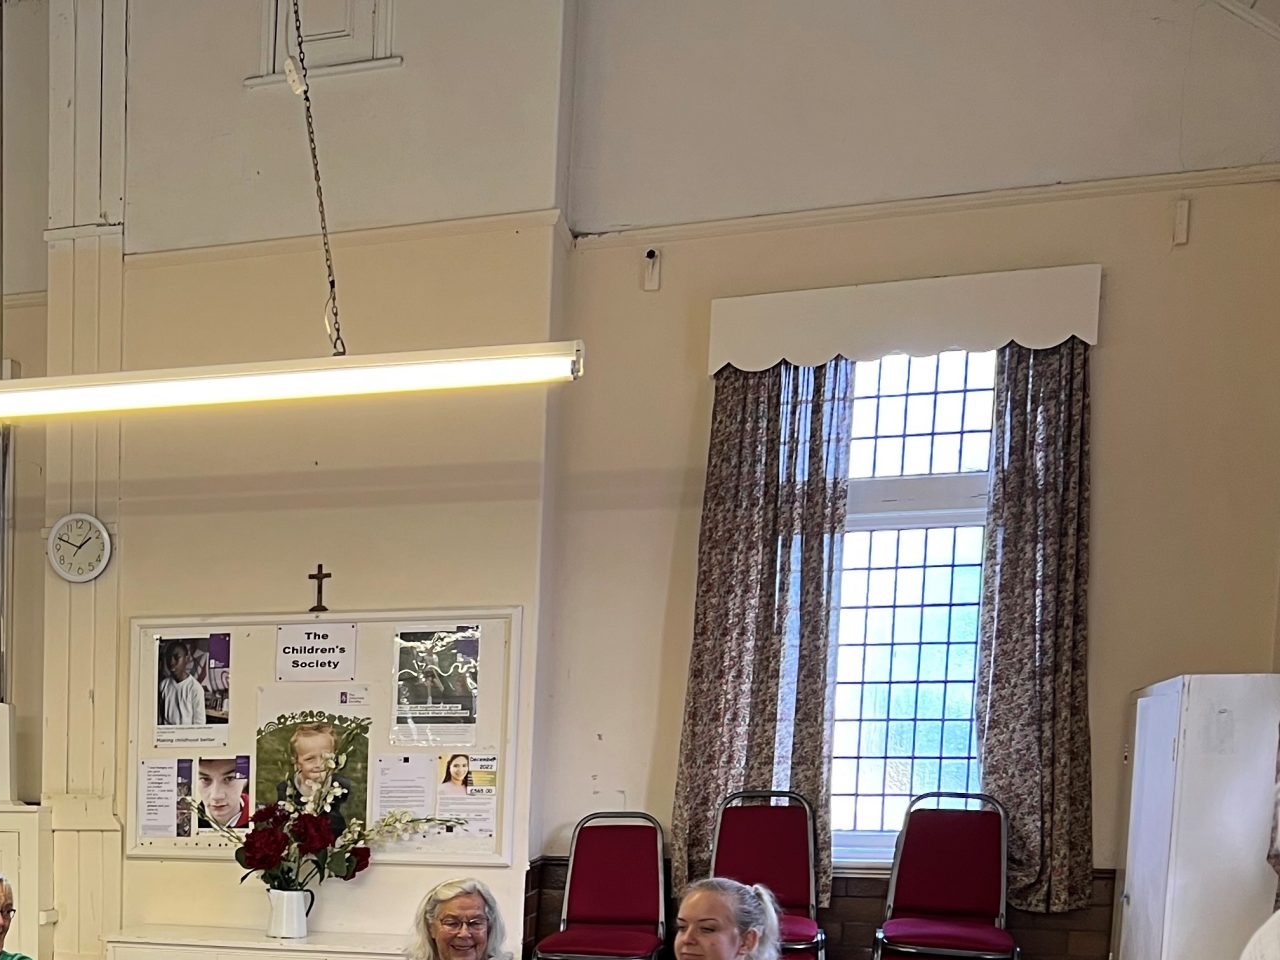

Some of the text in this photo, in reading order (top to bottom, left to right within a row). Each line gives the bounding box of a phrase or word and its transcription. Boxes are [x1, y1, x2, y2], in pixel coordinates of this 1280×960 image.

[76, 520, 84, 529] 12
[95, 530, 101, 540] 2
[55, 544, 61, 553] 9
[60, 555, 65, 565] 8
[67, 562, 72, 572] 7
[77, 566, 84, 576] 6
[88, 562, 94, 572] 5
[304, 632, 329, 640] The
[282, 645, 346, 654] Children's
[292, 660, 340, 670] Society
